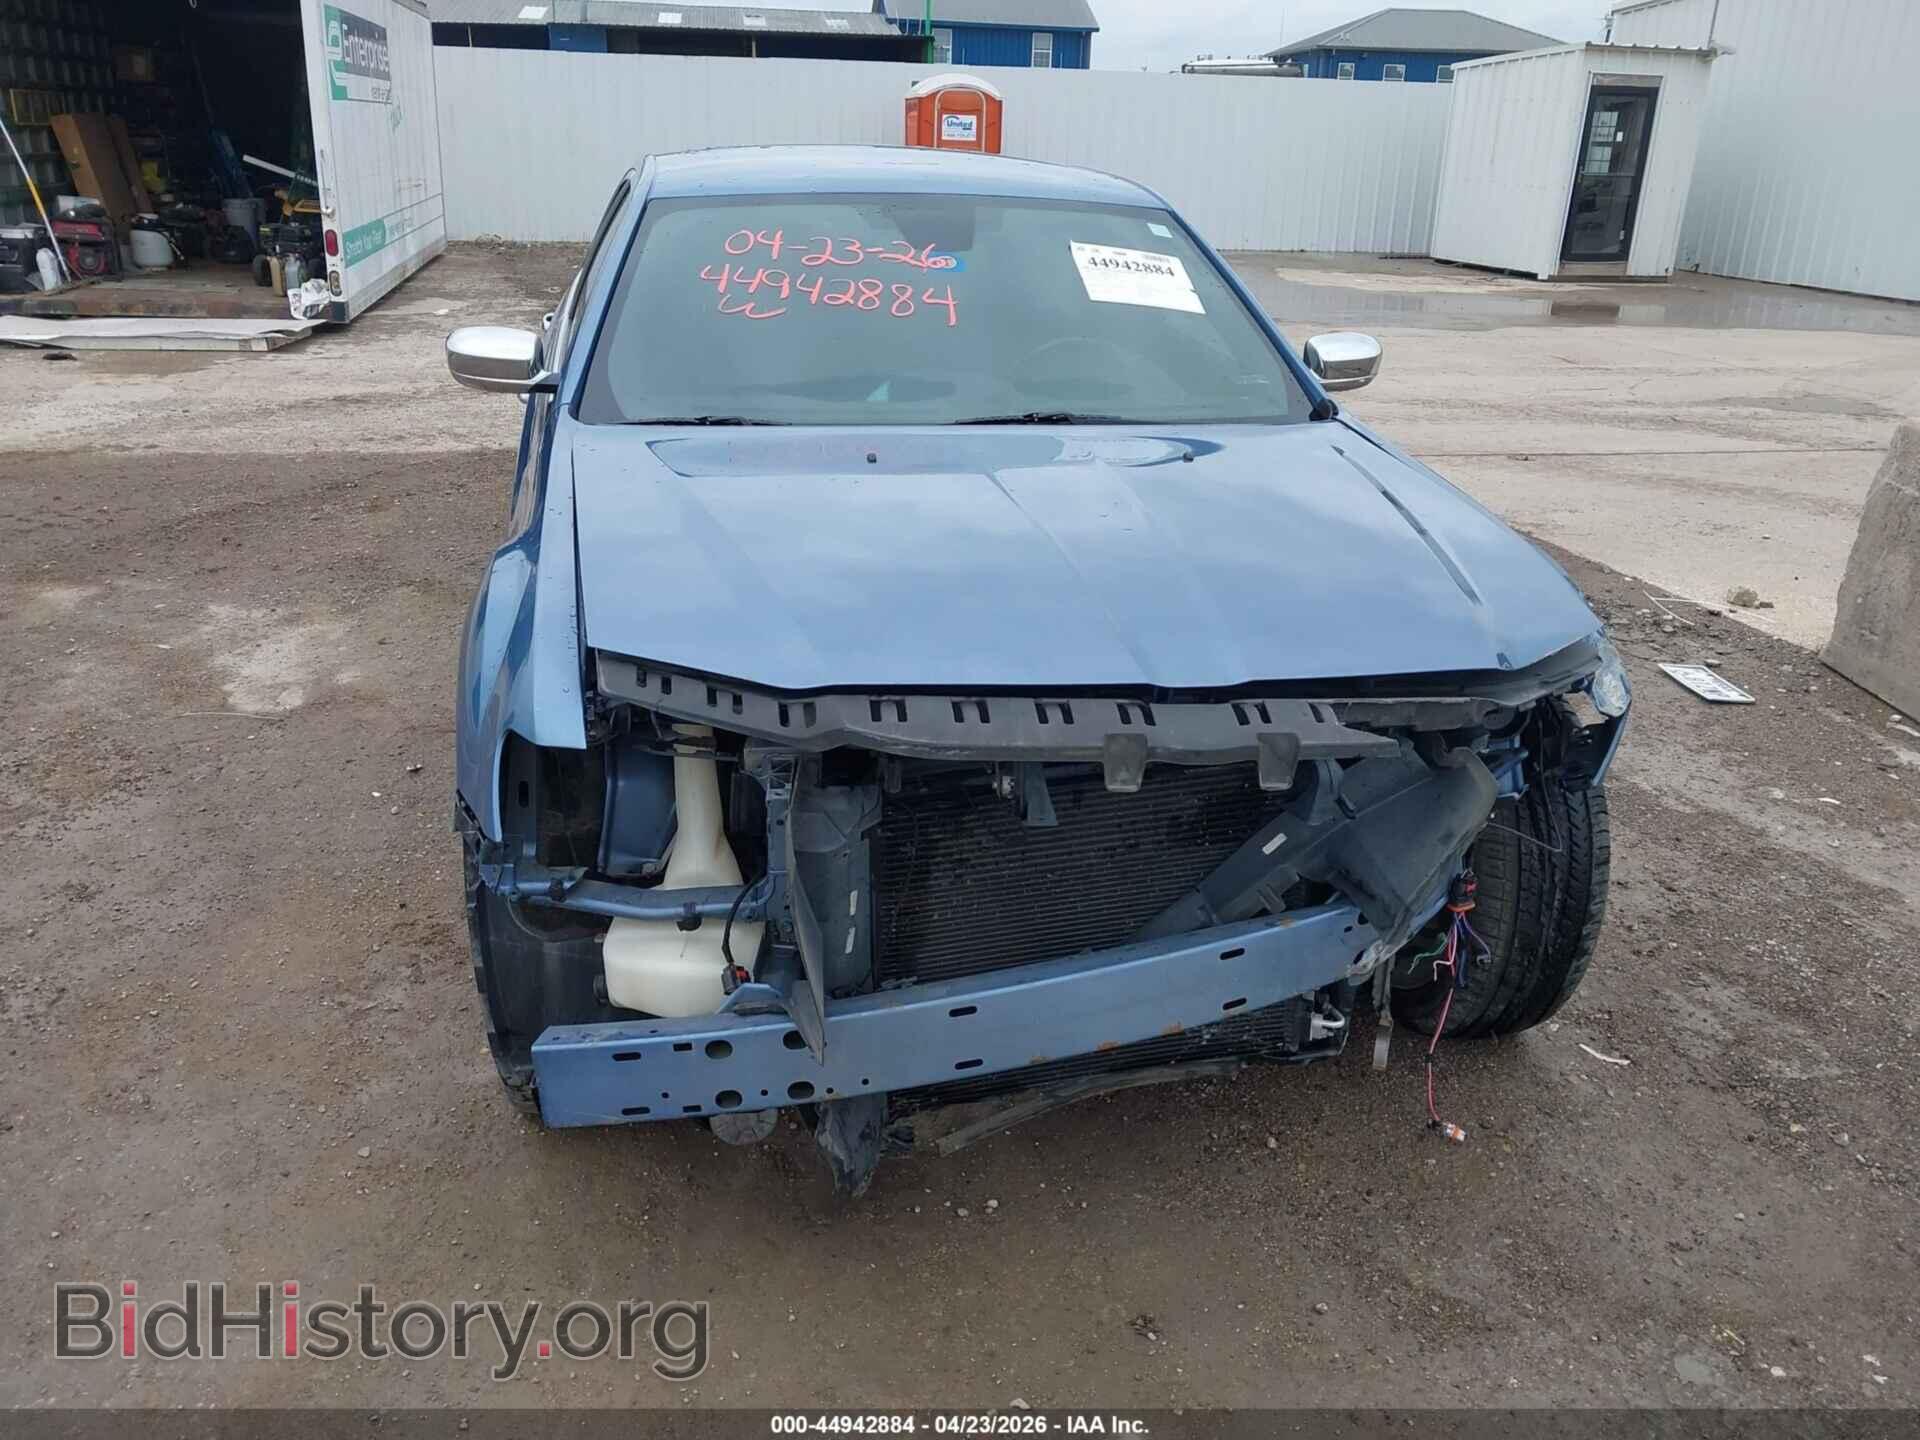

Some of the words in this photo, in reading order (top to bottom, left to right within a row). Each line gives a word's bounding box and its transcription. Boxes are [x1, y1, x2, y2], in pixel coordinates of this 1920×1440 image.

[342, 23, 390, 73] Enterprise
[724, 229, 958, 271] 04-23-26
[1088, 256, 1176, 277] 44942884
[699, 263, 960, 327] 44942884
